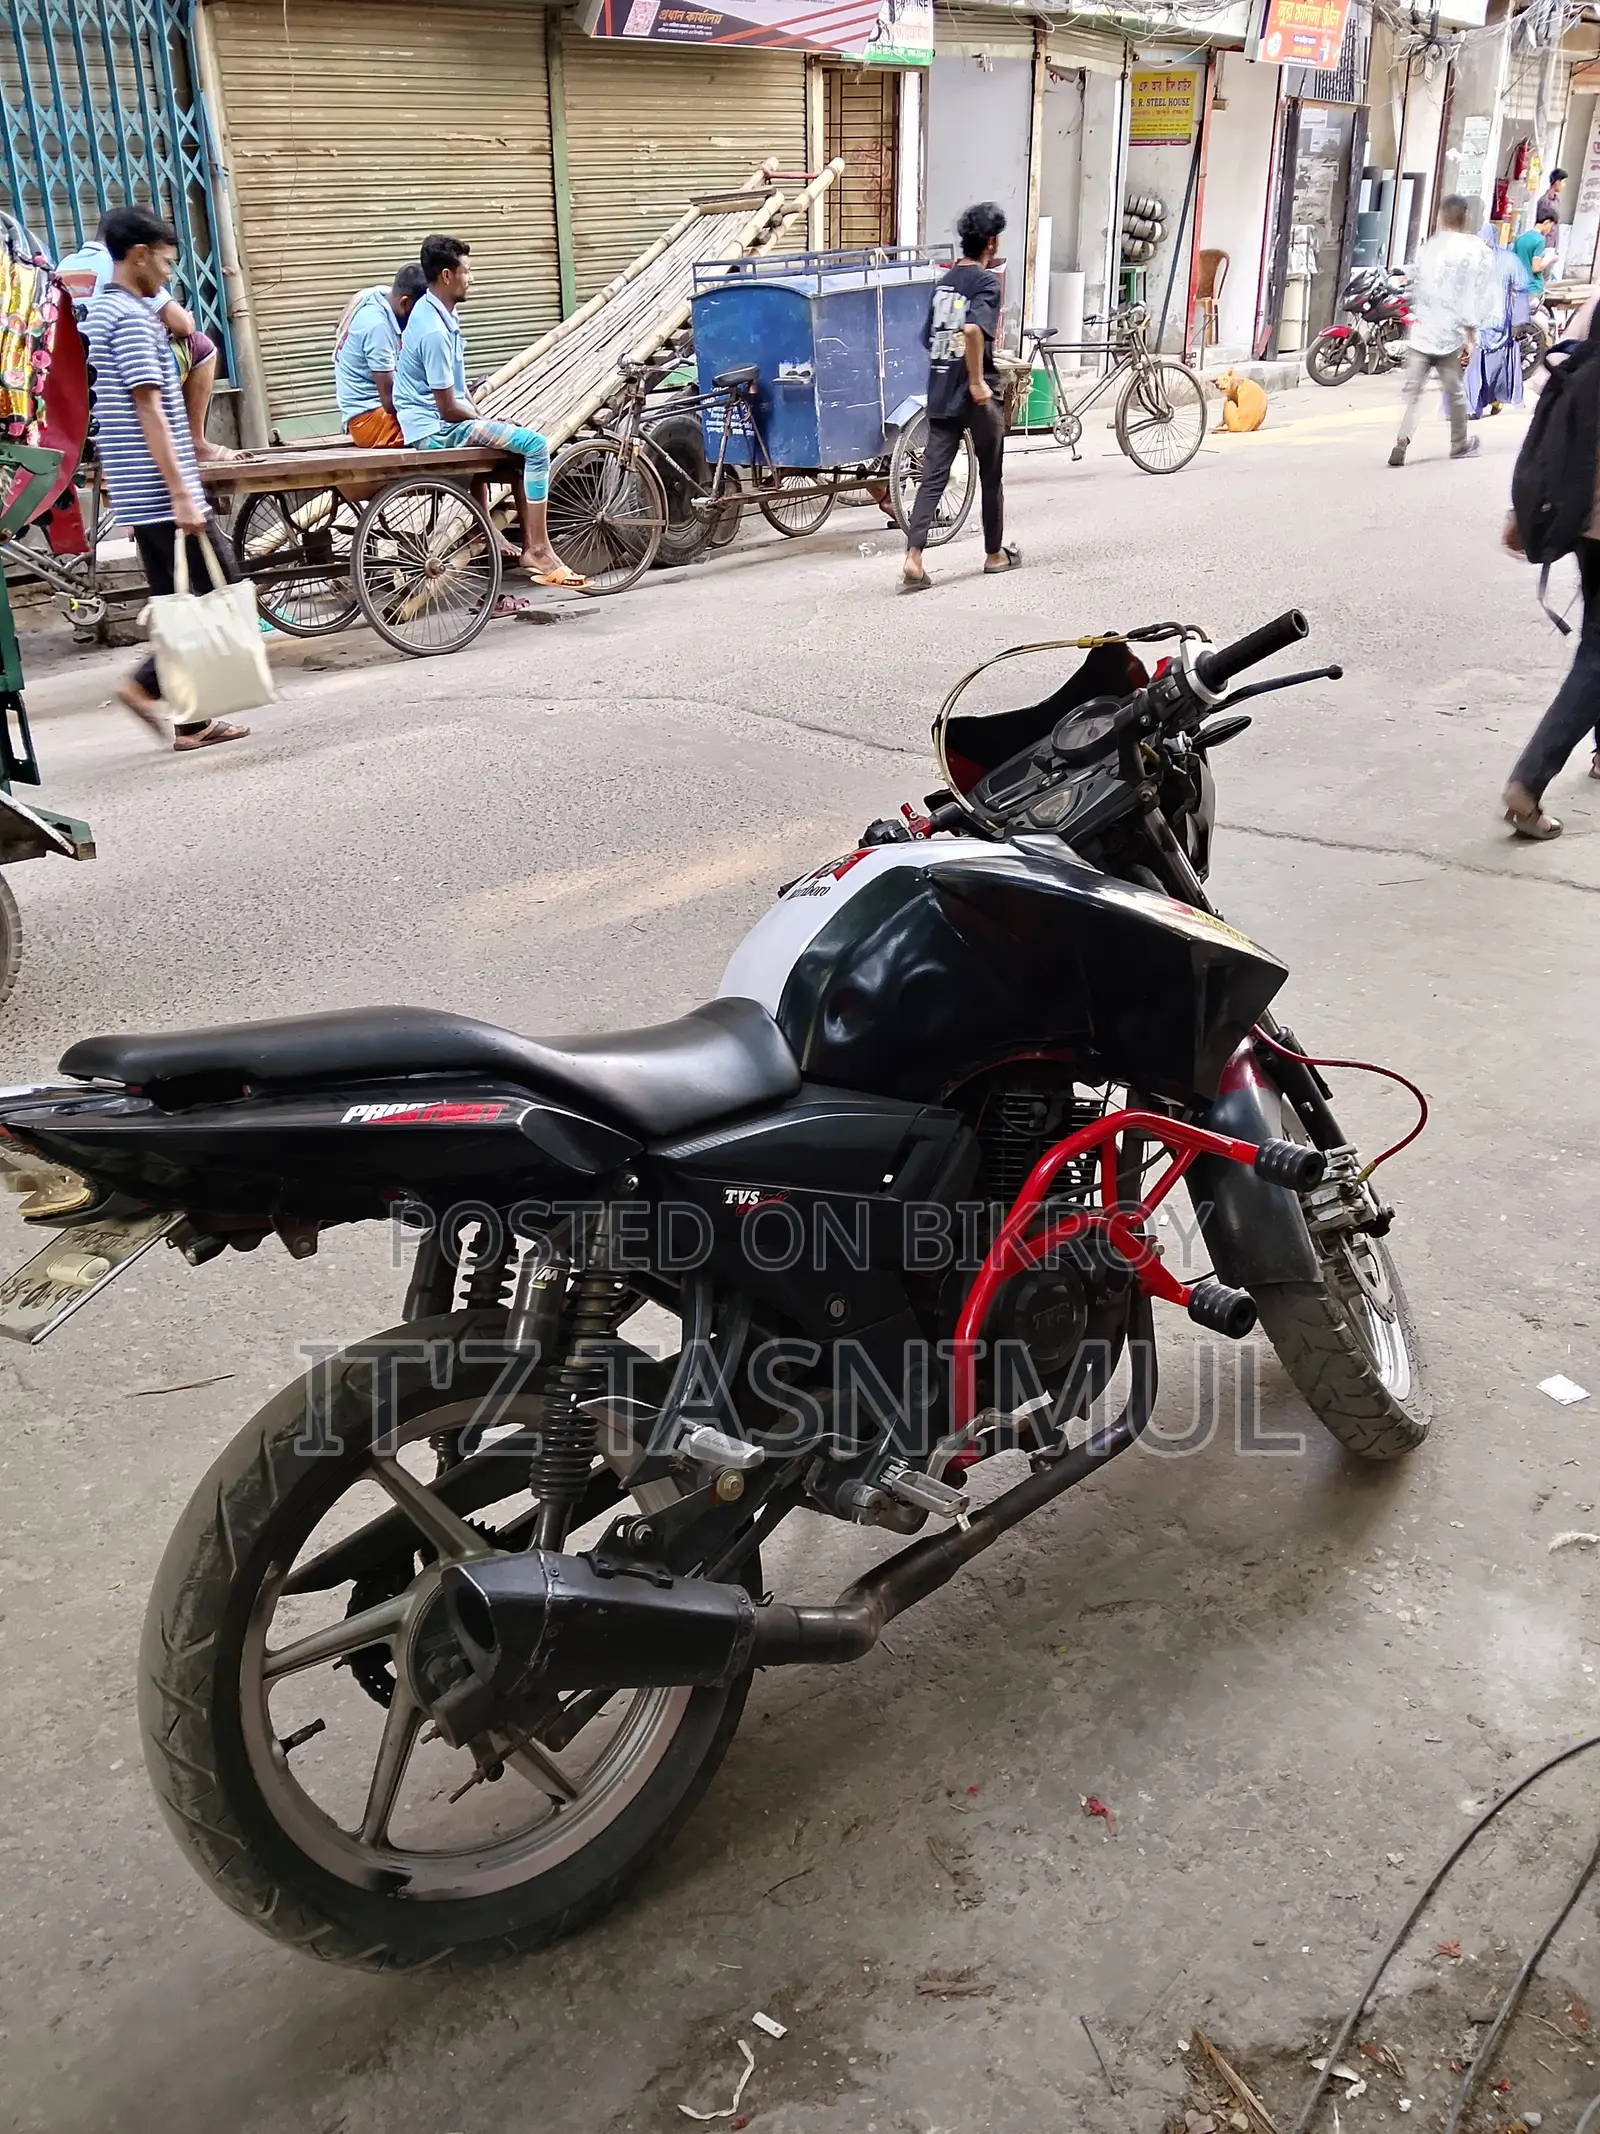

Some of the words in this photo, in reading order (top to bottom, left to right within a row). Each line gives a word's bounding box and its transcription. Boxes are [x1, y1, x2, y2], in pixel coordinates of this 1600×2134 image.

[659, 9, 685, 21] প্রধান
[686, 9, 723, 25] কার্যালয়
[1146, 97, 1167, 107] STEEL
[1168, 97, 1190, 107] HOUSE
[725, 1189, 760, 1205] TVS
